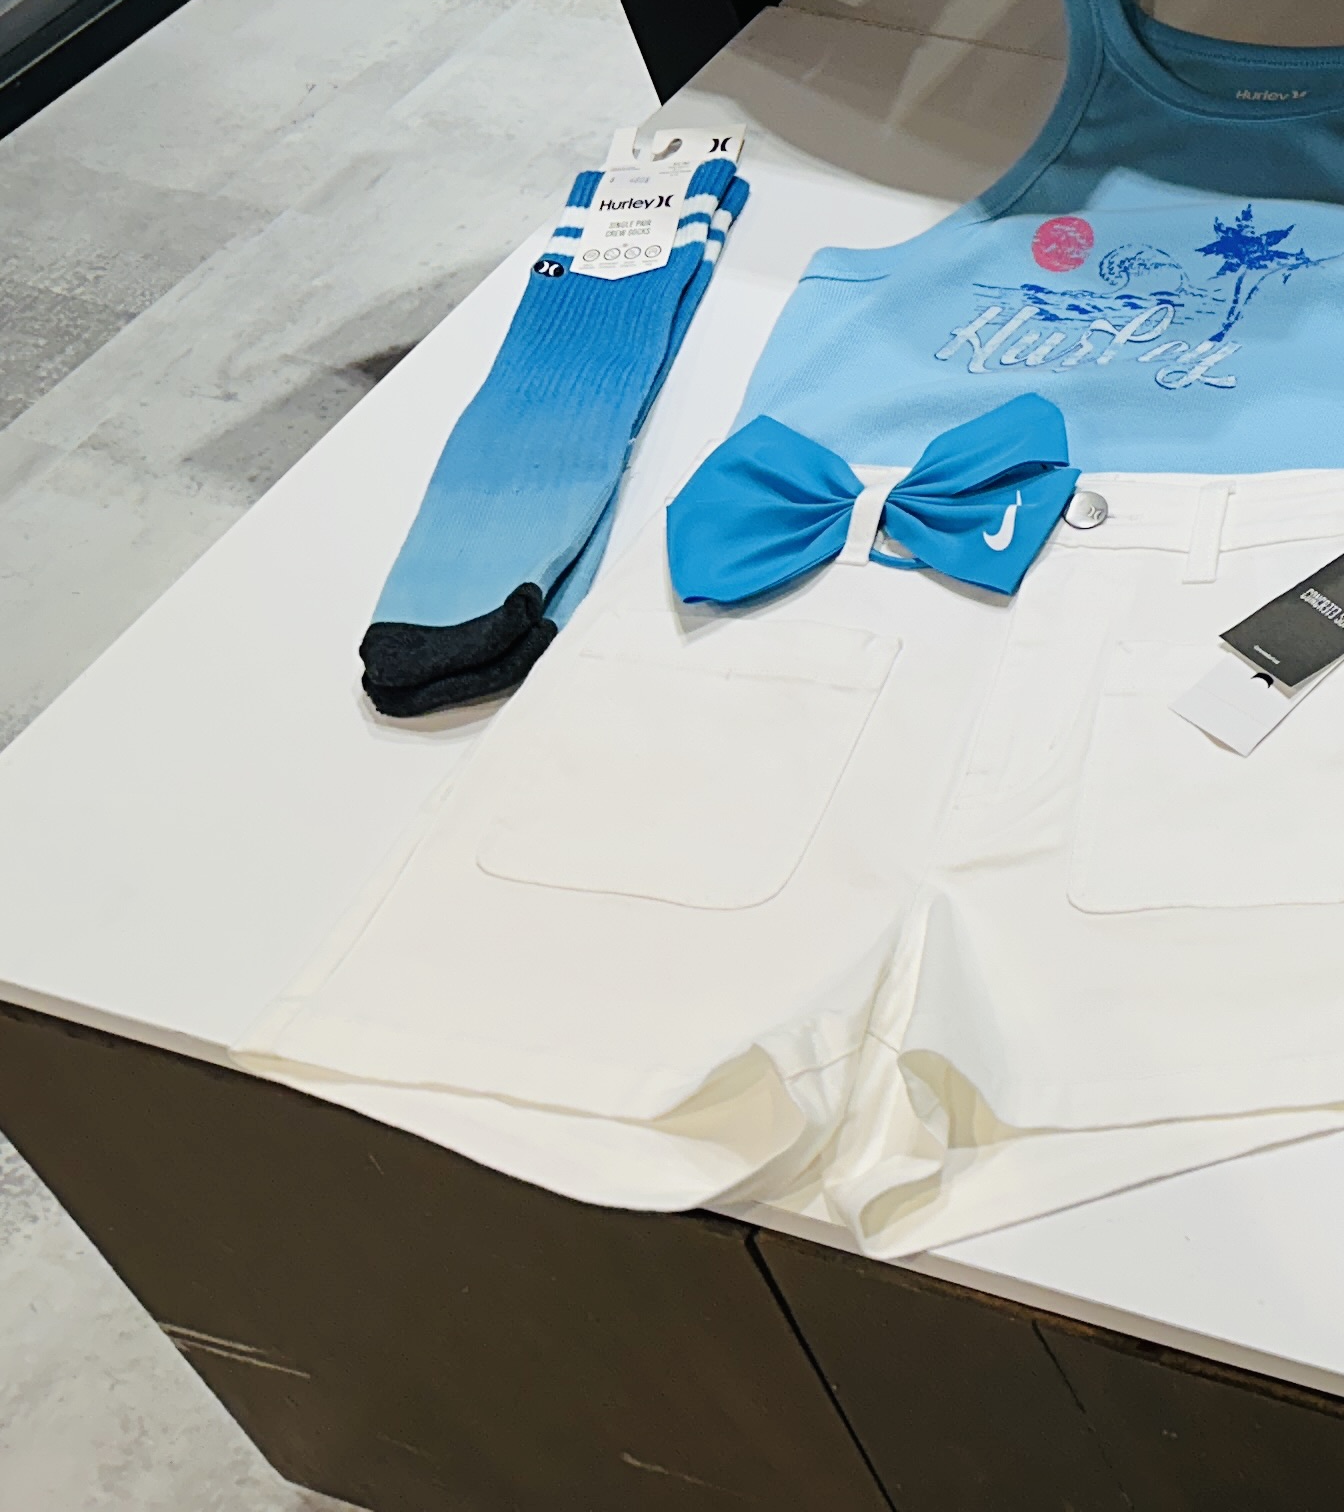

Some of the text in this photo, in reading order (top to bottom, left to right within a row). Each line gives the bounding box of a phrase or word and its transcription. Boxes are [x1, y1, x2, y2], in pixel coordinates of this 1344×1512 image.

[1236, 89, 1290, 101] Hurley
[599, 197, 656, 211] Hurley
[935, 304, 1243, 390] Hurley
